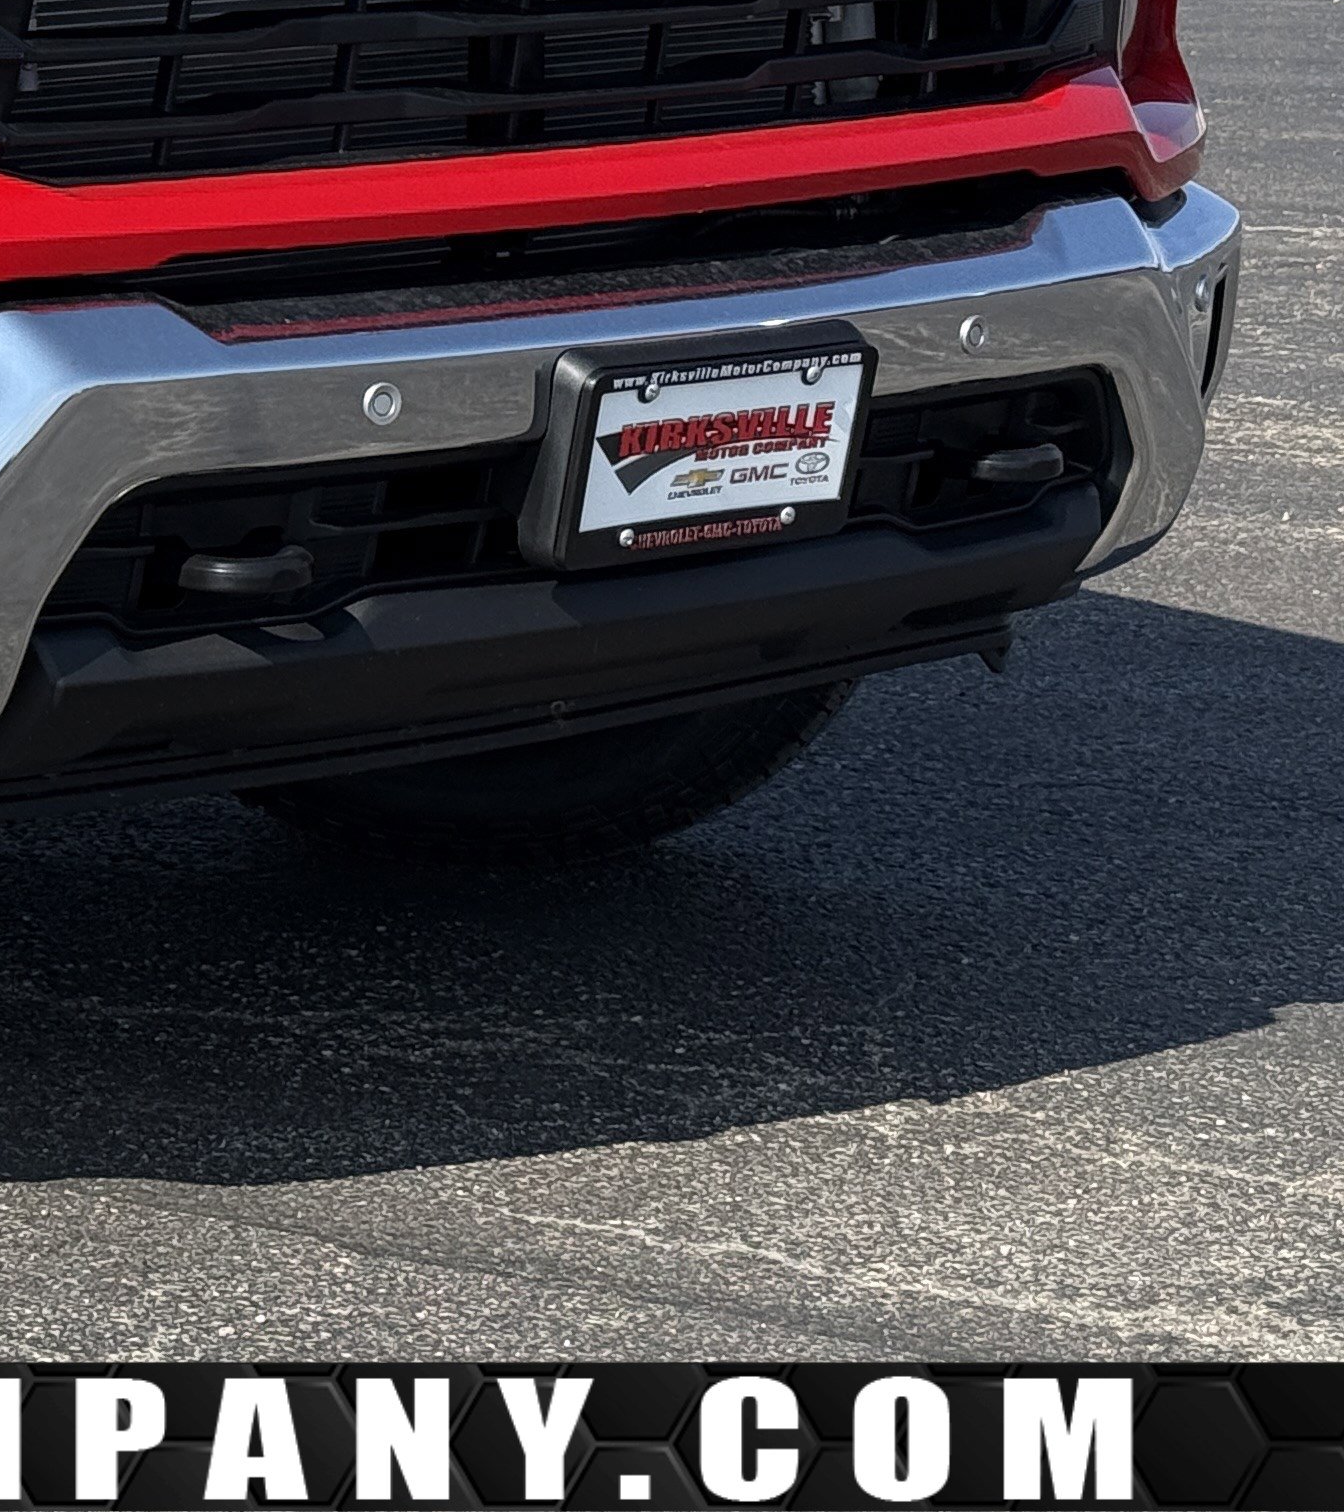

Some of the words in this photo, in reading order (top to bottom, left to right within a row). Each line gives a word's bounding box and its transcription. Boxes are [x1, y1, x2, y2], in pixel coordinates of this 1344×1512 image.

[617, 400, 837, 459] KIRKSVILLE
[693, 442, 750, 463] MOTOR
[752, 435, 827, 456] COMPANY
[729, 462, 790, 485] GMC
[789, 474, 830, 487] TOYOTA
[666, 485, 724, 501] CHEVROLET
